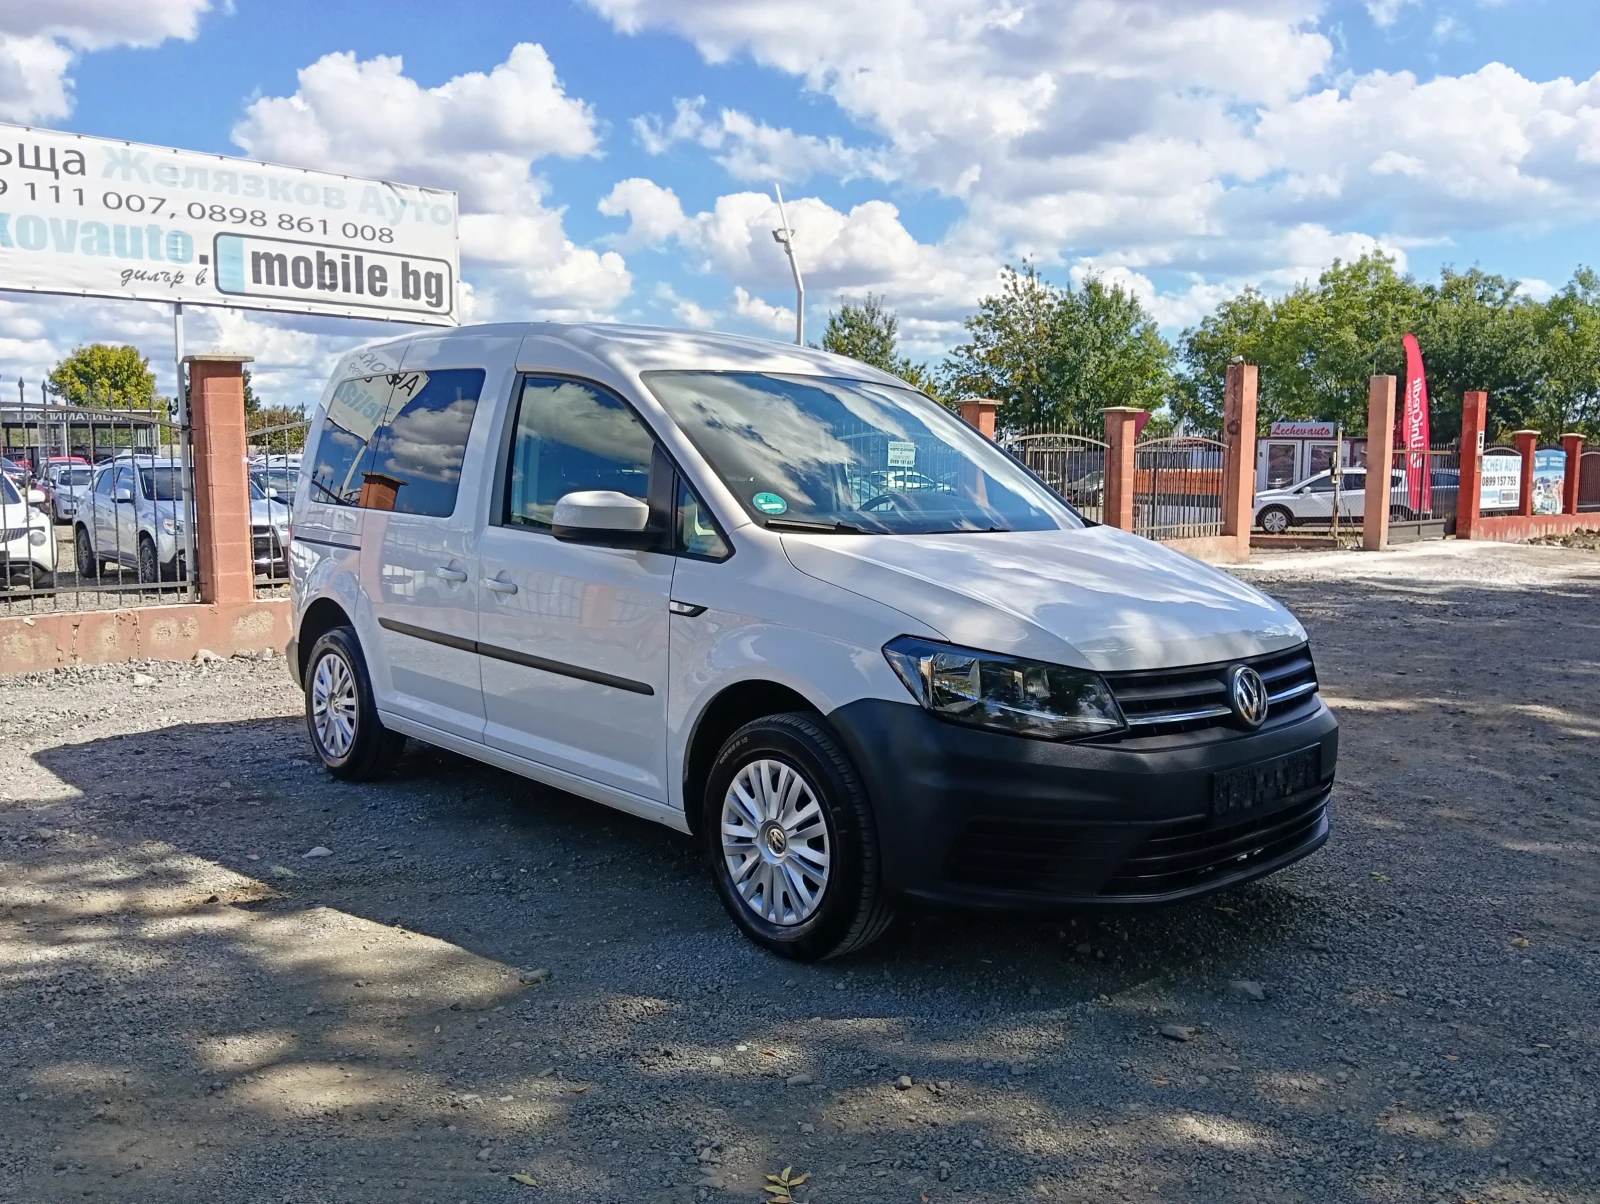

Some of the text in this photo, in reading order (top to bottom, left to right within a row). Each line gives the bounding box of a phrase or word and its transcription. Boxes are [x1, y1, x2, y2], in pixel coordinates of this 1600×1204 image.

[101, 145, 347, 210] Желязков
[358, 185, 453, 227] Ауто
[24, 182, 84, 206] 111
[102, 191, 176, 220] 007,
[187, 202, 267, 227] 0898
[277, 213, 328, 235] 861
[341, 222, 394, 244] 008
[120, 268, 186, 288] дилър
[251, 250, 444, 308] mobile.bg
[1272, 423, 1331, 436] Lechev auto
[1482, 475, 1496, 487] 0899
[1497, 475, 1506, 486] 157
